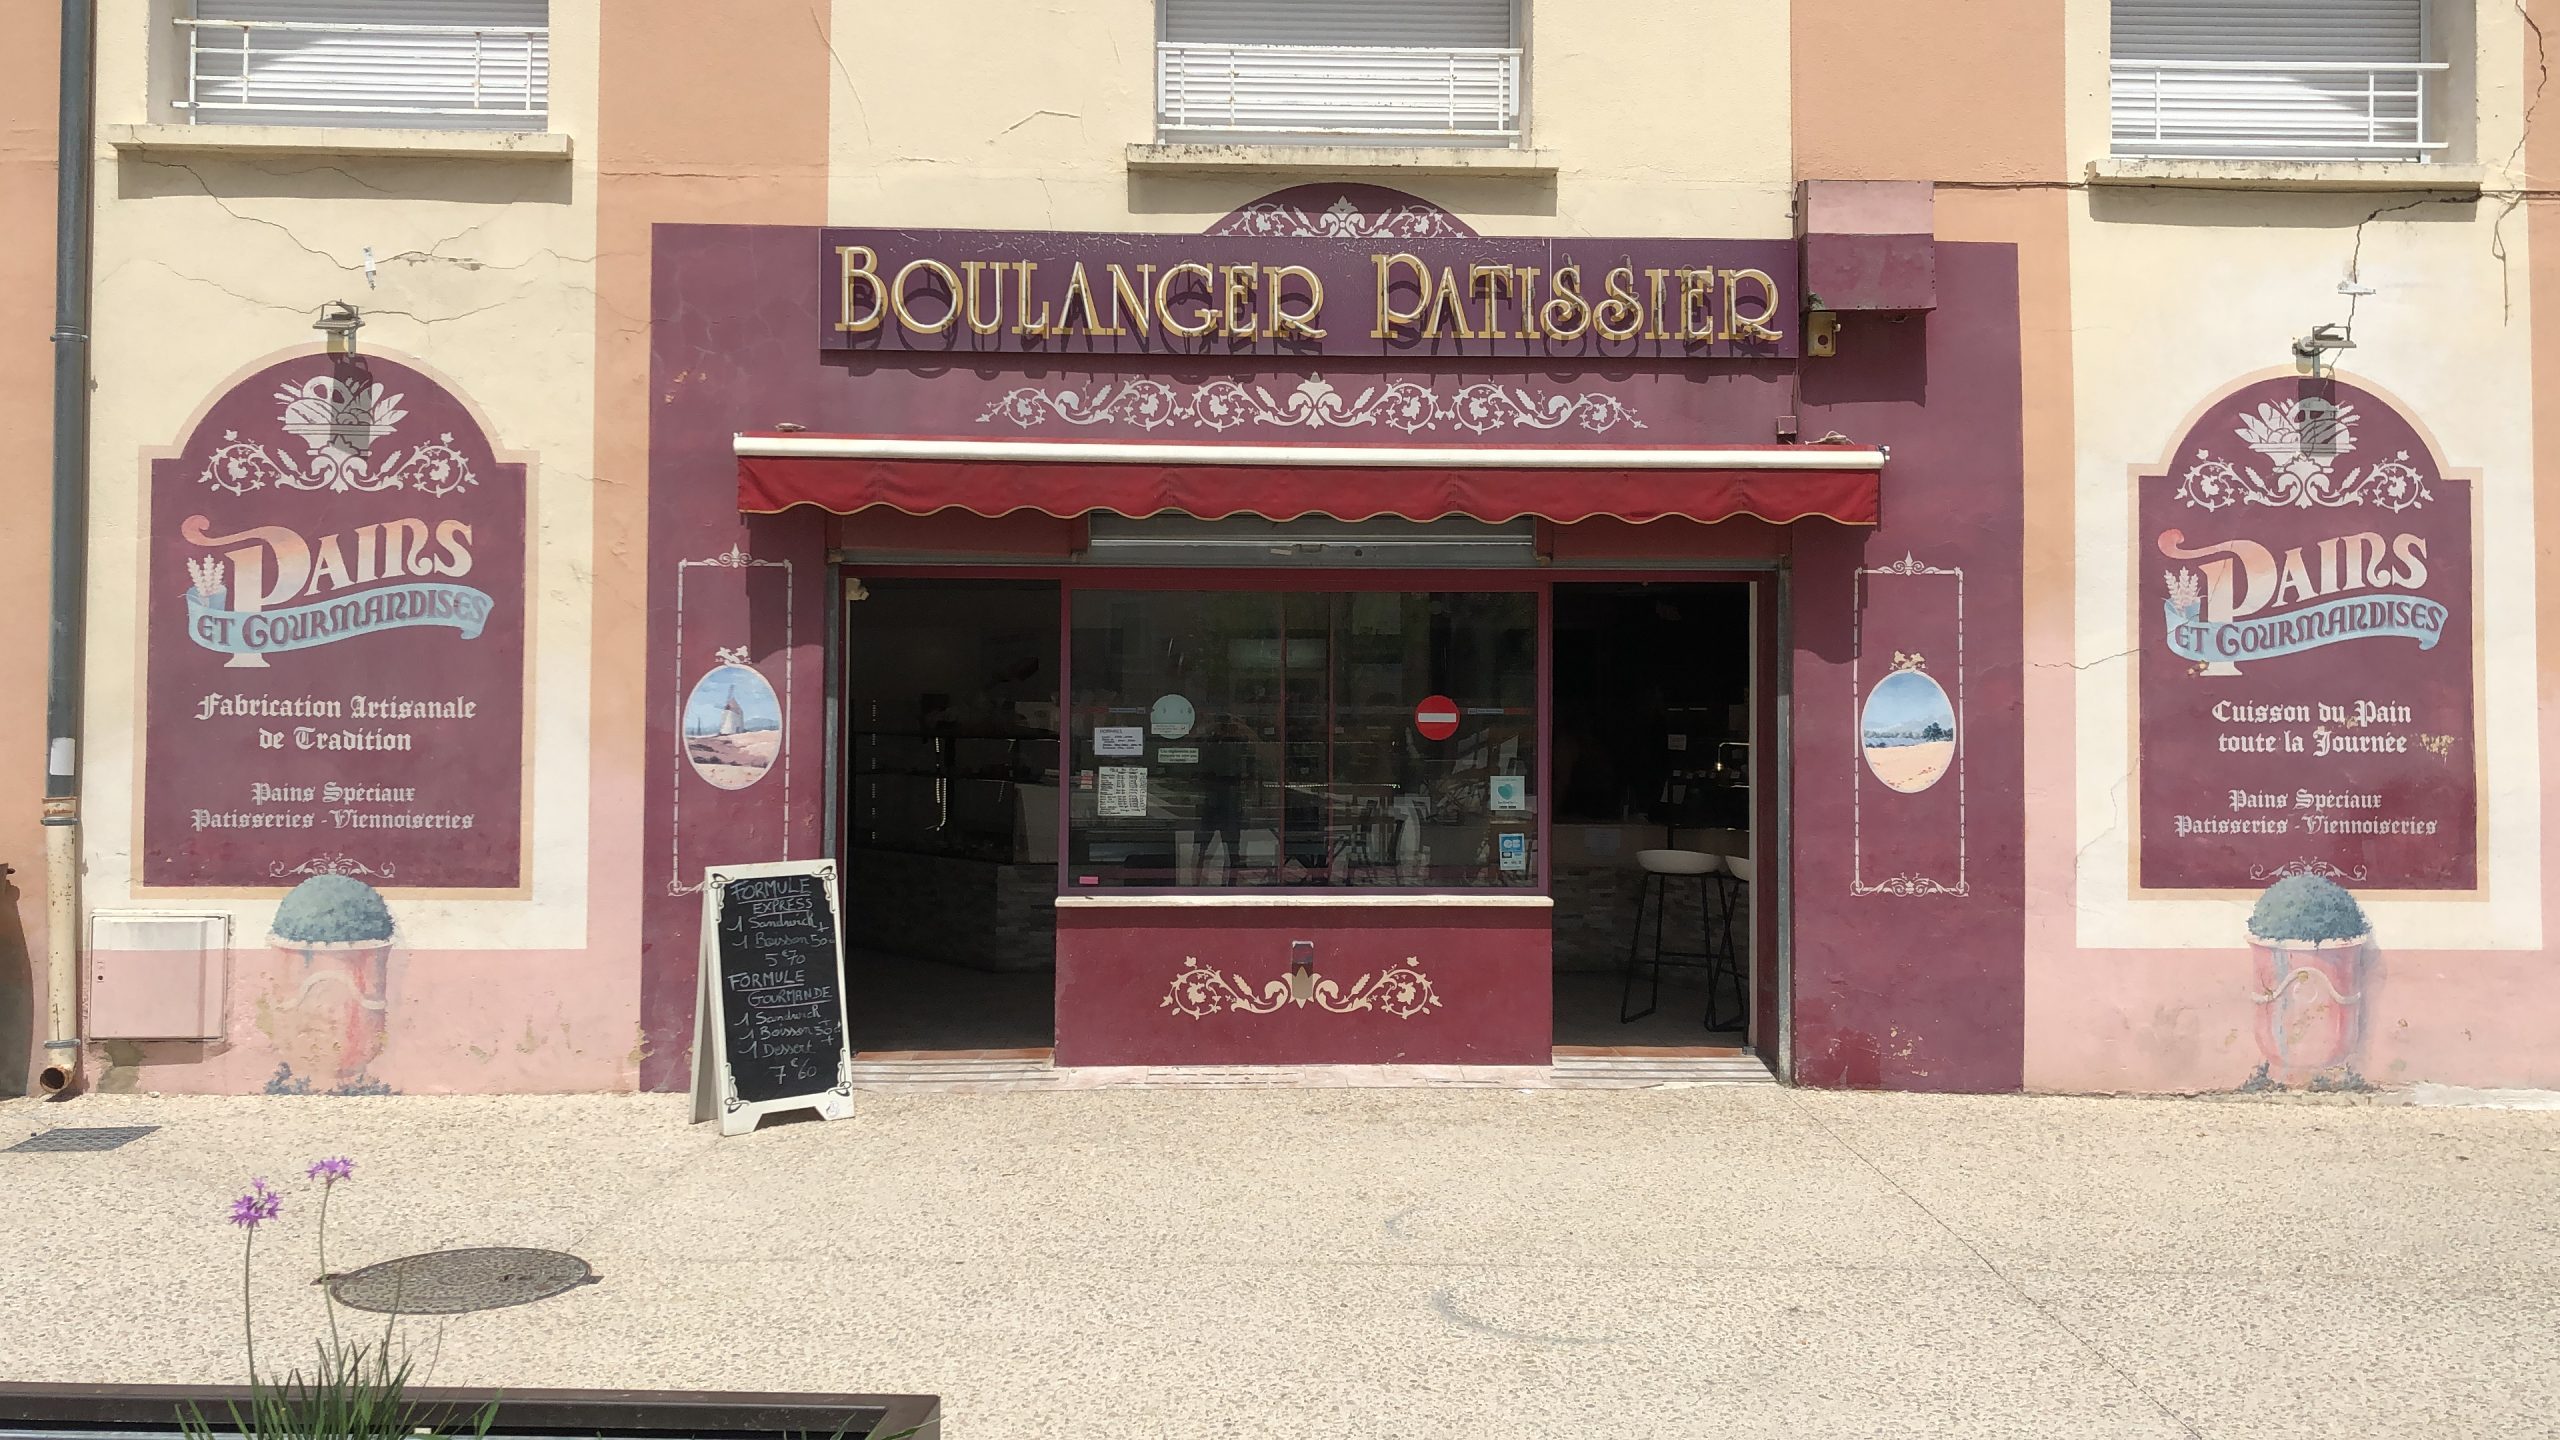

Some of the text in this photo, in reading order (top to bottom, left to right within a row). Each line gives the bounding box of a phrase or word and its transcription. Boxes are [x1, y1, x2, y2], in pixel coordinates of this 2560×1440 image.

[834, 245, 1784, 344] BOULANGER PATISSIER
[198, 589, 489, 649] ET GOURMANDISES
[2174, 601, 2444, 657] ET GOURMANDISES
[194, 693, 477, 720] Fabrication Artisanale
[2211, 700, 2412, 727] Cuisson du Pain
[258, 727, 412, 751] de Tradition
[2218, 729, 2408, 757] toute la Journée
[250, 781, 416, 806] Pains Spéciaux
[2228, 788, 2383, 812] Pains Spéciaux
[191, 808, 315, 831] Patisseries
[2174, 816, 2288, 838] Patisseries
[730, 878, 812, 901] FORMULE
[753, 898, 813, 914] EXPRESS
[726, 916, 743, 932] 1
[748, 911, 817, 929] Sandwich
[732, 935, 748, 949] 1
[755, 932, 809, 949] Boisson
[727, 969, 805, 991] FORMULE
[748, 986, 833, 1007] GOURMANDE
[734, 1012, 750, 1026] 1
[755, 1005, 821, 1025] Sandwich
[739, 1030, 754, 1040] 1
[760, 1023, 813, 1040] Boisson
[738, 1040, 816, 1059] 1 Dessert
